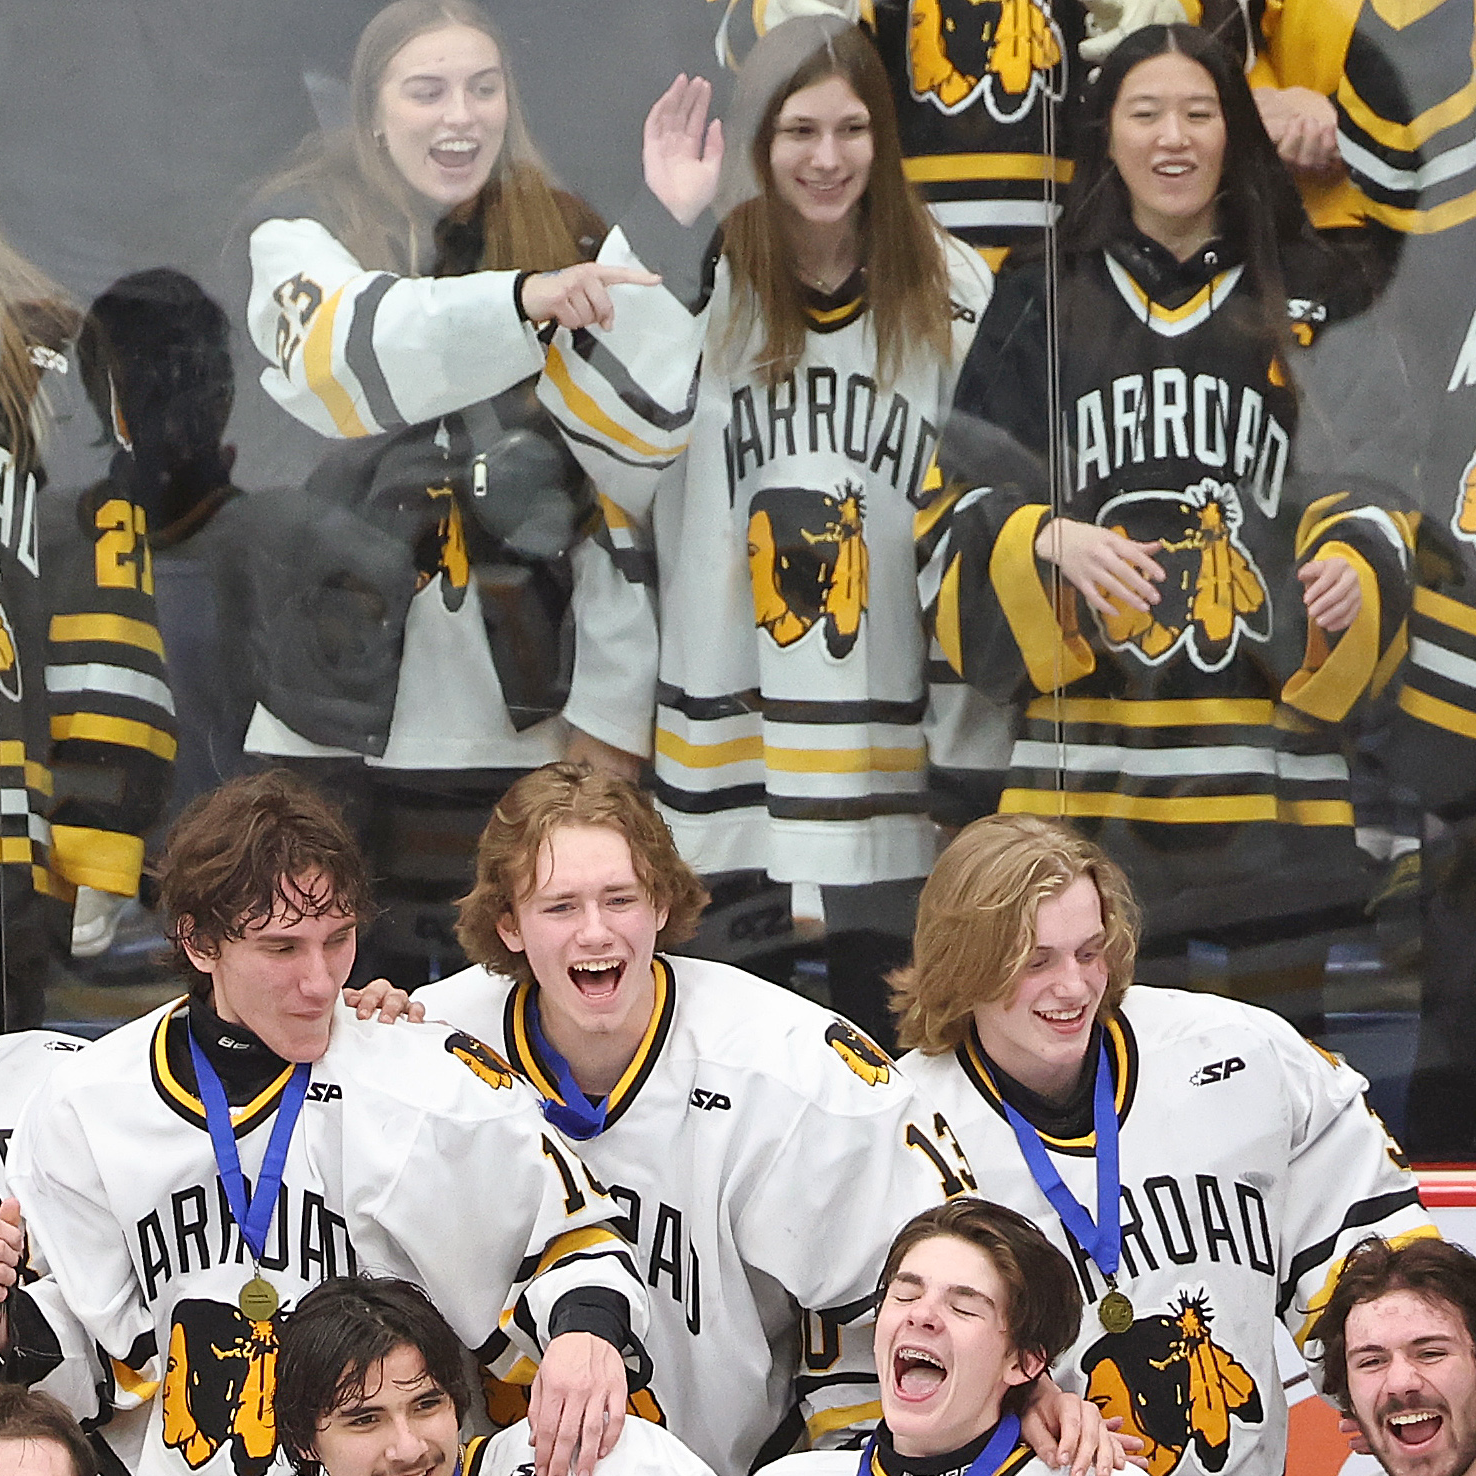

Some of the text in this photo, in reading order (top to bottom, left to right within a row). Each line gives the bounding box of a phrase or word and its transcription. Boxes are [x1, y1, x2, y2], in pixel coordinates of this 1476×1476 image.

[1064, 369, 1288, 519] ARROAD
[1200, 1056, 1246, 1086] SP
[305, 1082, 342, 1102] SP
[690, 1088, 732, 1110] SP
